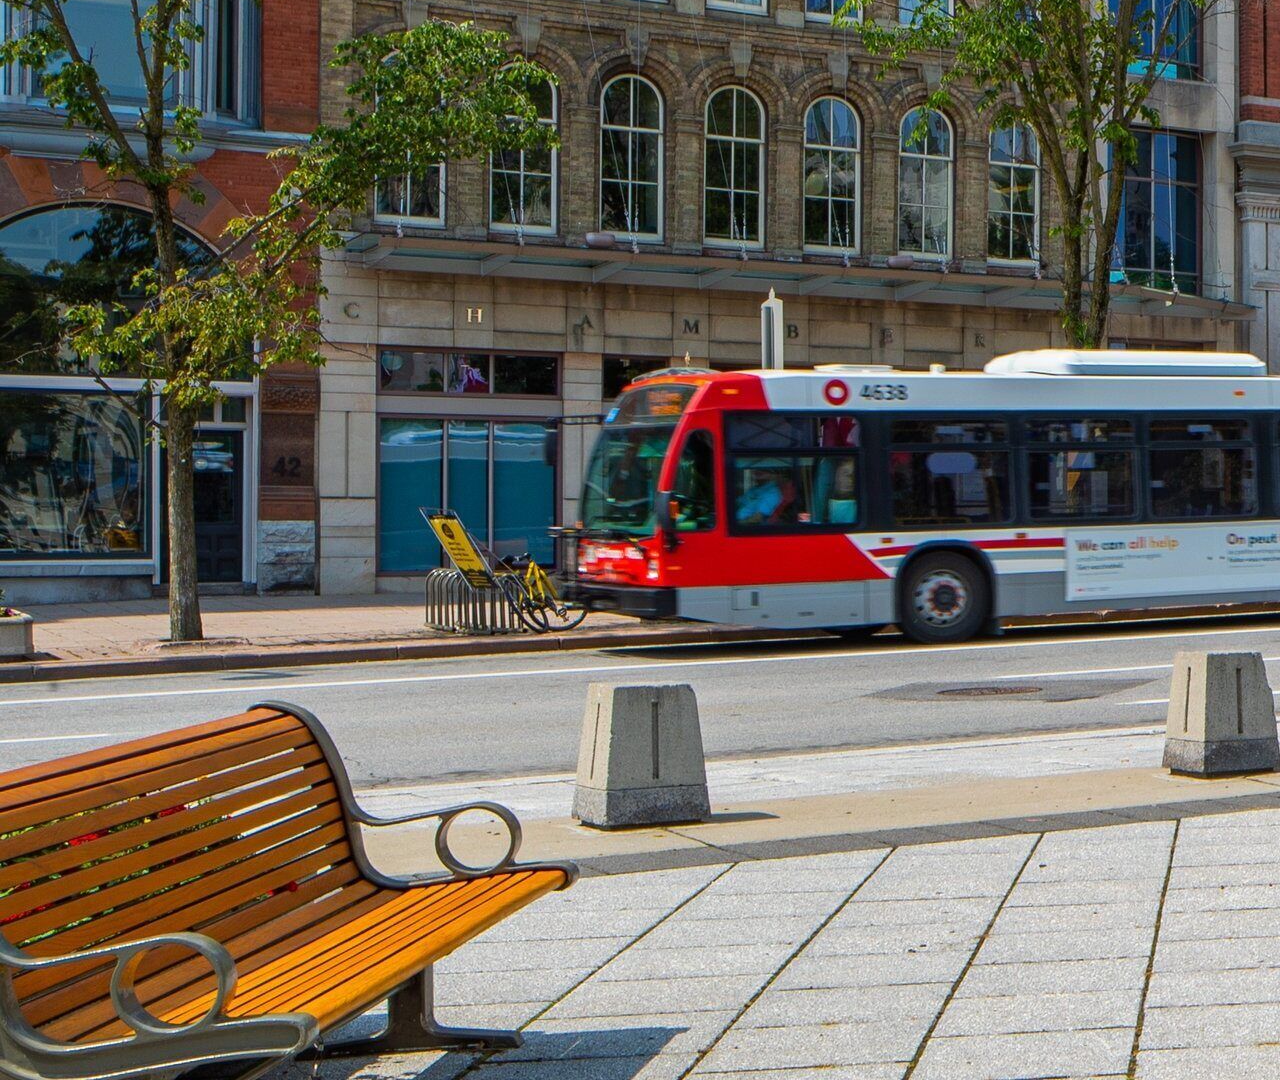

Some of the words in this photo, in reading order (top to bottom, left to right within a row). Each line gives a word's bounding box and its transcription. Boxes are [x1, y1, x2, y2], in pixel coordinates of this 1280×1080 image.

[859, 384, 909, 401] 4638
[272, 456, 301, 477] 42
[1076, 539, 1099, 551] We
[1101, 541, 1126, 550] can
[1128, 536, 1147, 549] all
[1149, 535, 1180, 551] help
[1226, 533, 1246, 545] On
[1248, 533, 1278, 547] peut
